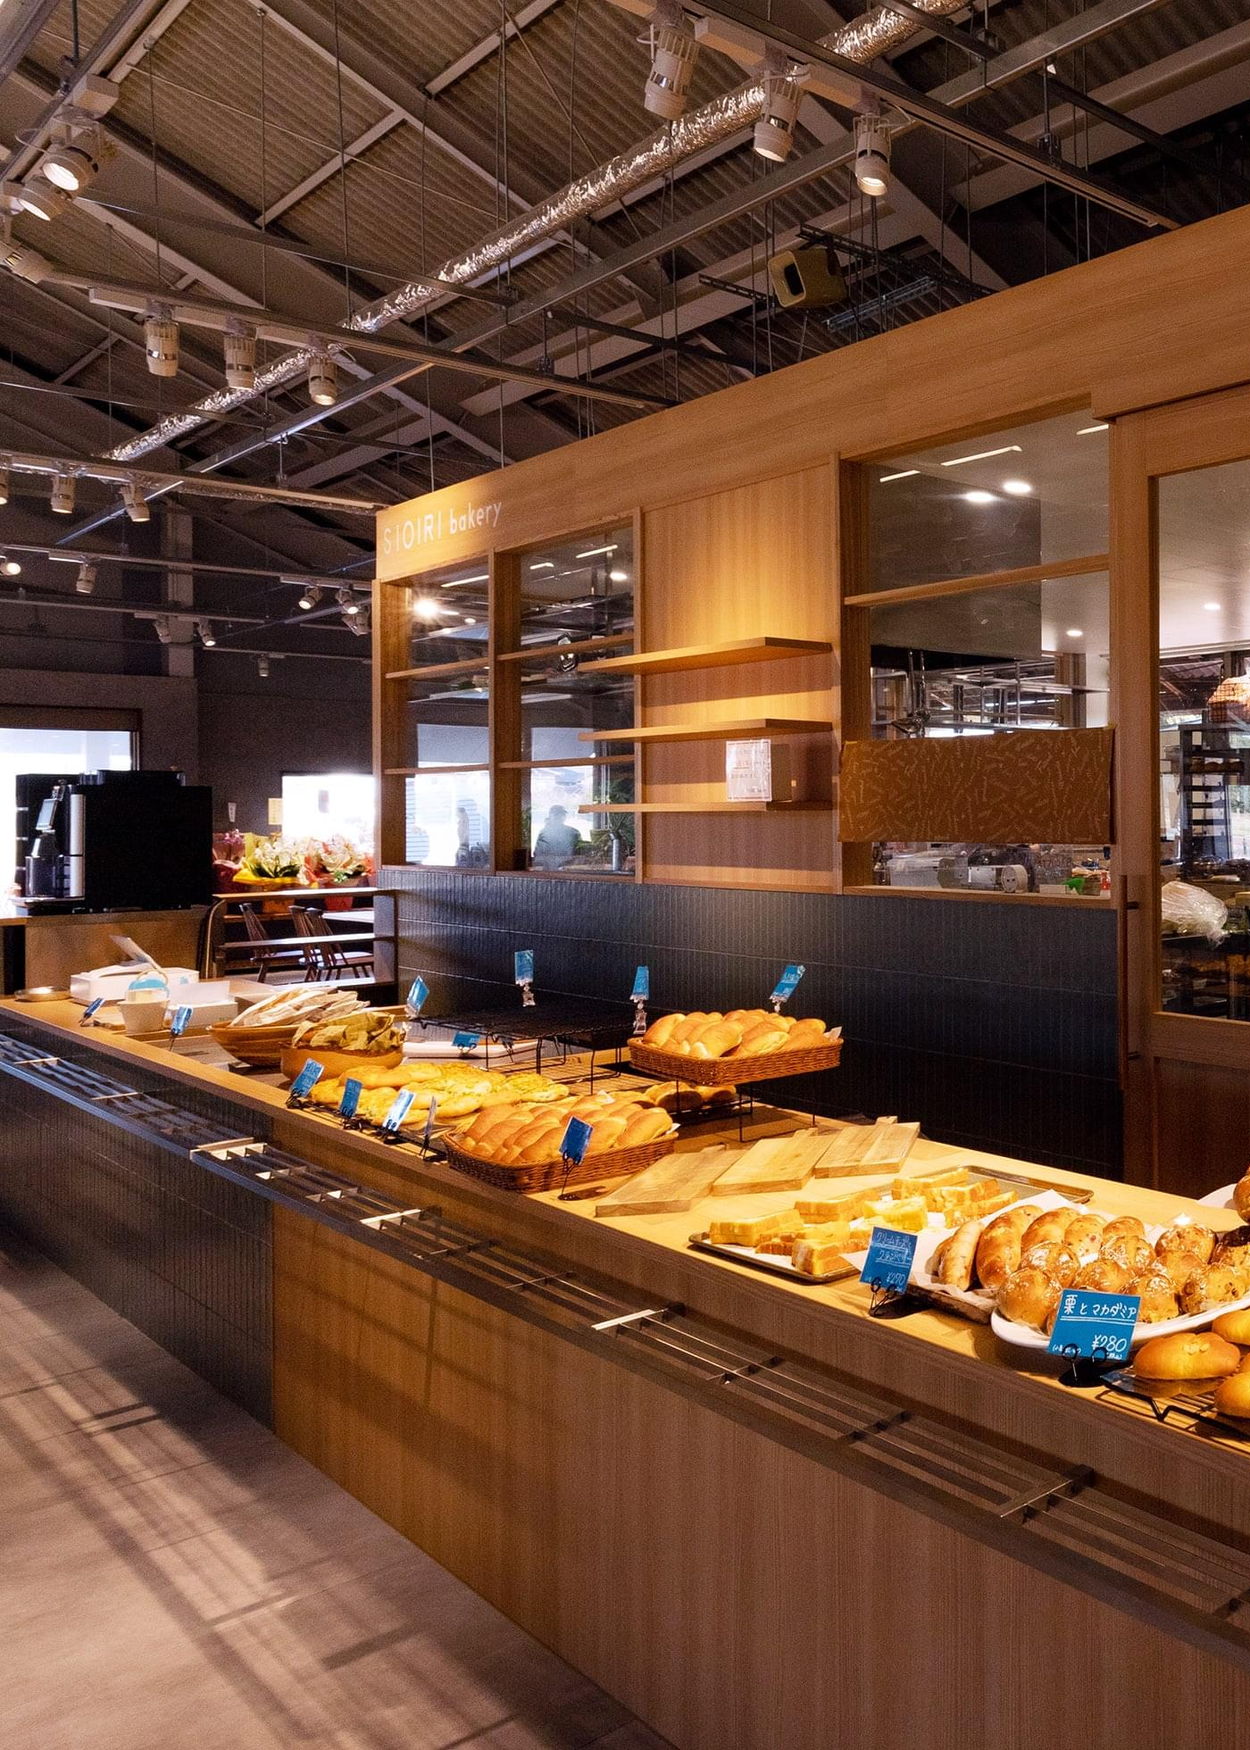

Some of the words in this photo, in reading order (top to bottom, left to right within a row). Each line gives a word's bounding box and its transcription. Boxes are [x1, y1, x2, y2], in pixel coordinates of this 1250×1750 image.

[383, 510, 442, 555] SIOIRI
[449, 501, 502, 535] bakery
[1063, 1294, 1137, 1318] 栗とマカダミア
[1091, 1334, 1127, 1352] ¥280
